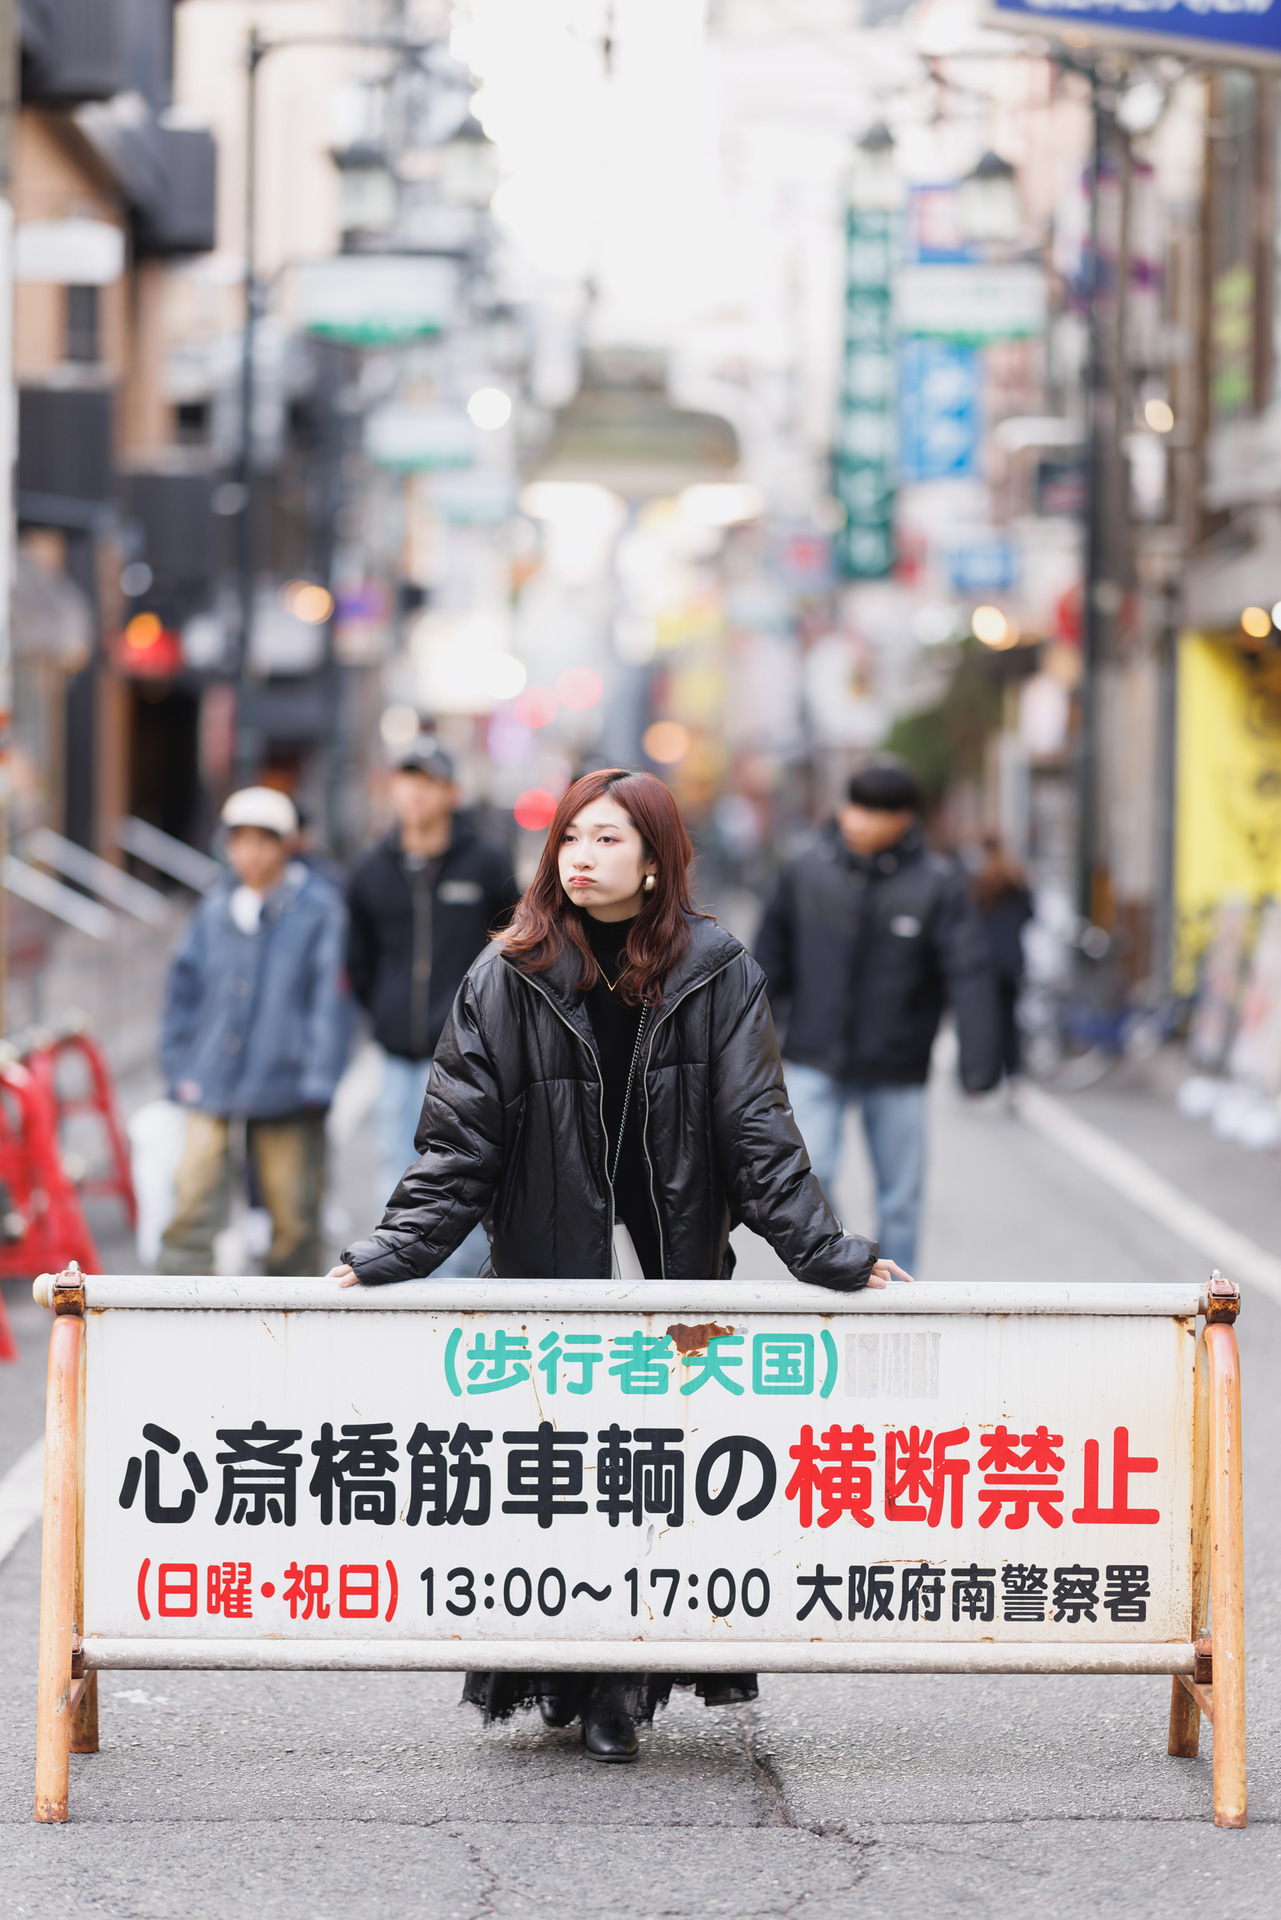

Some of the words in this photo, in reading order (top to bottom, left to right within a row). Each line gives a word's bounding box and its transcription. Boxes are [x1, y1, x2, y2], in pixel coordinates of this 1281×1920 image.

[796, 1562, 1151, 1624] 大阪府南警察署
